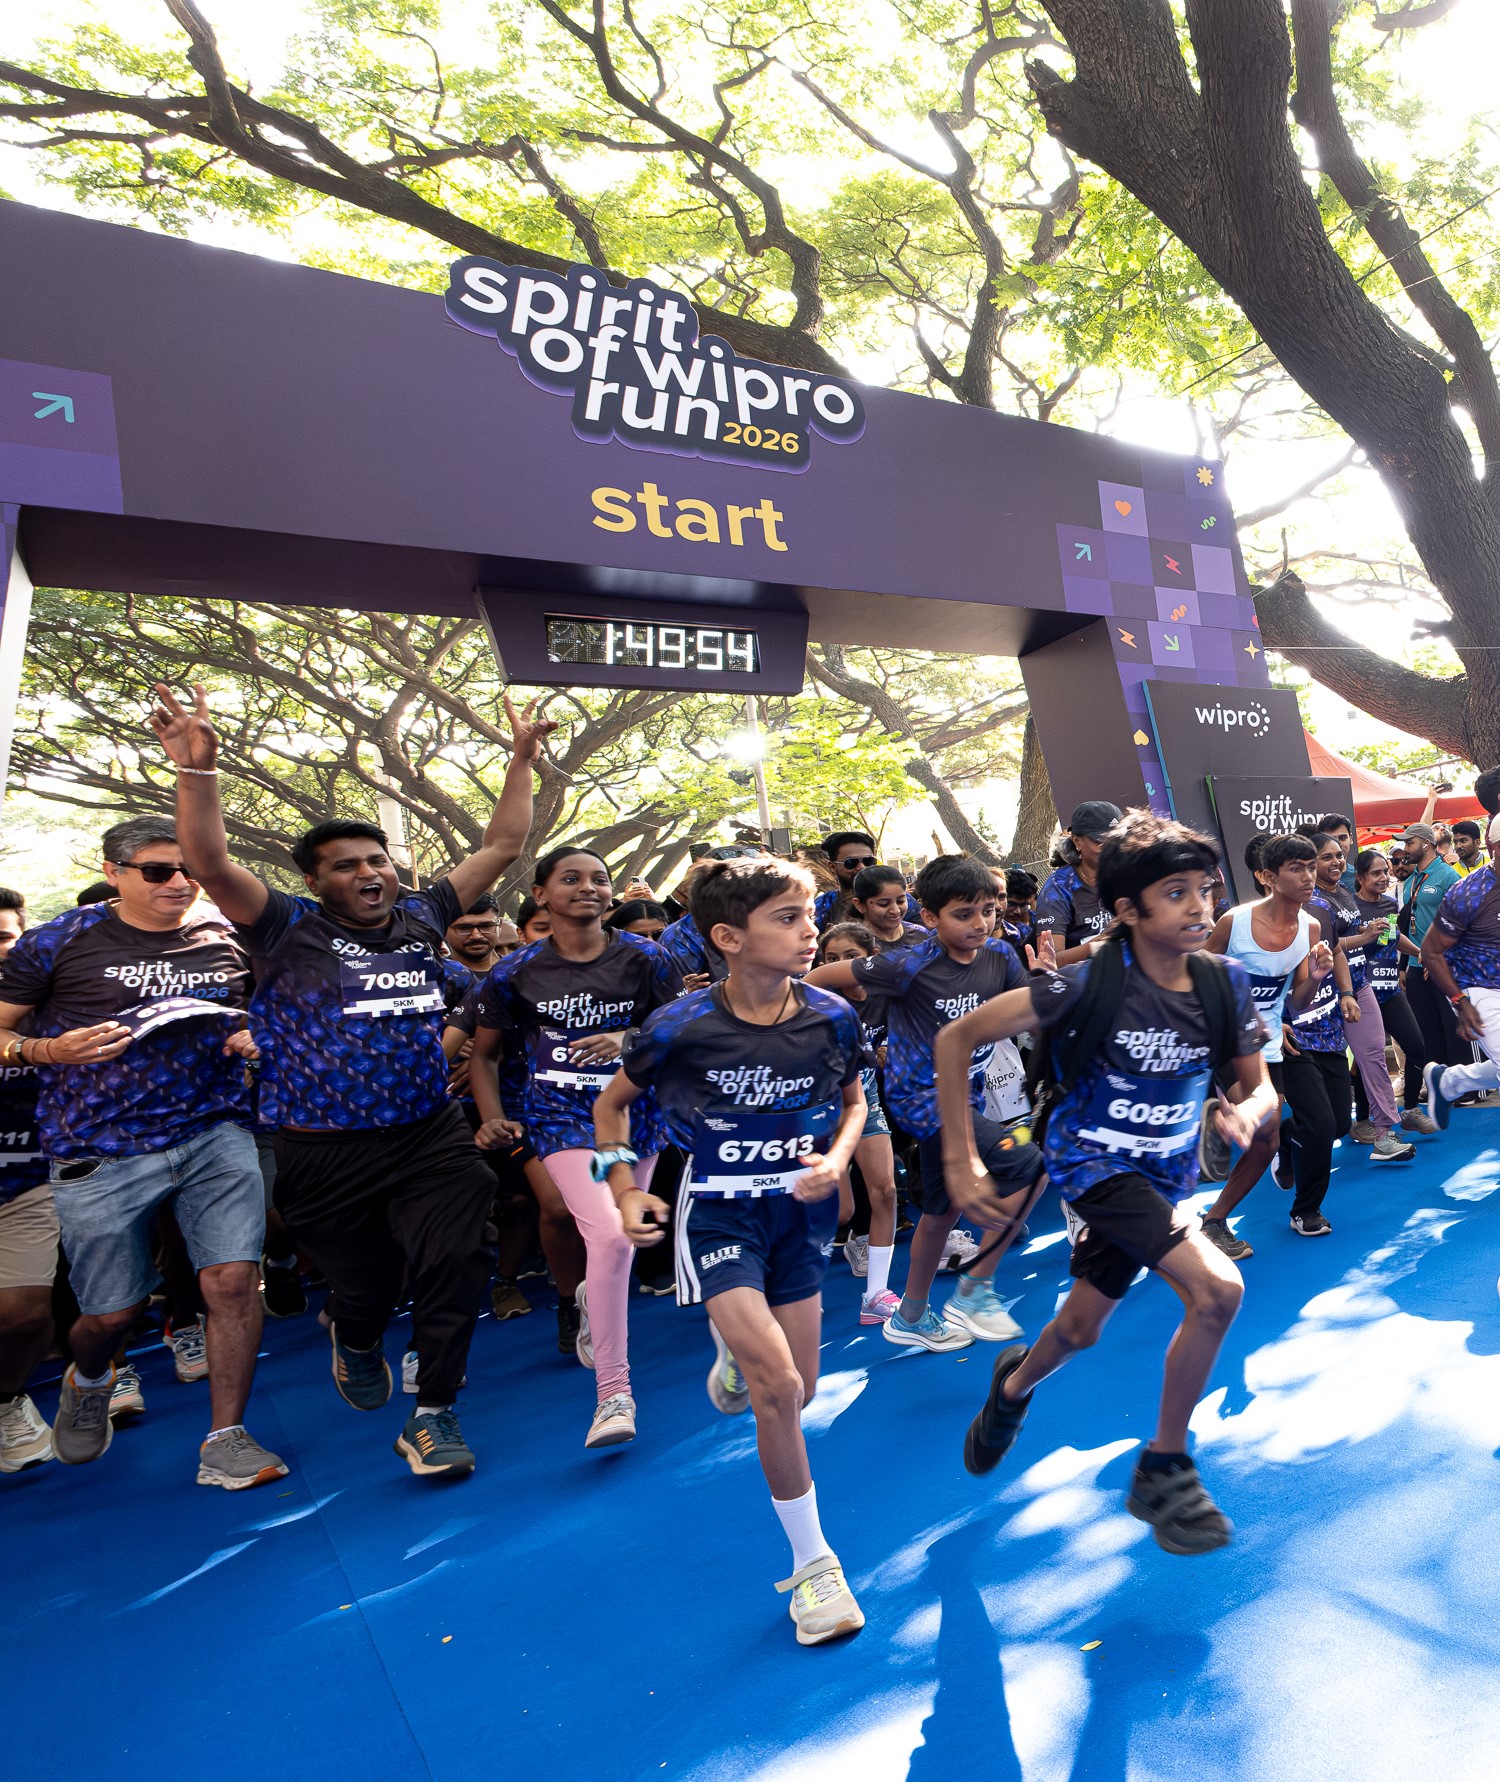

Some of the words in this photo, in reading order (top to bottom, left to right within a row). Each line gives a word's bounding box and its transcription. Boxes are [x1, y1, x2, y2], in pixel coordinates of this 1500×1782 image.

[459, 266, 686, 352] spirit
[529, 325, 628, 380] of
[633, 345, 856, 425] wipro
[584, 376, 720, 441] run
[722, 421, 800, 454] 2026
[590, 481, 789, 552] start
[606, 623, 753, 673] 1:49:54
[1194, 702, 1261, 733] wipro
[1239, 794, 1292, 820] spirit
[1255, 809, 1279, 830] of
[1280, 808, 1332, 829] wipr
[104, 961, 173, 981] spirit
[124, 972, 157, 988] of
[158, 969, 228, 990] wipro
[359, 970, 426, 991] 70801
[139, 983, 184, 998] run
[184, 986, 230, 998] 2026
[1250, 986, 1278, 997] 077
[1309, 985, 1333, 1005] 343
[393, 999, 415, 1008] 5KM
[536, 992, 593, 1015] spirit
[552, 1006, 579, 1021] of
[579, 1000, 634, 1018] wipro
[935, 993, 980, 1012] spirit
[947, 1004, 967, 1019] of
[566, 1014, 602, 1028] run
[601, 1016, 632, 1028] 202
[1114, 1027, 1181, 1050] spirit
[1128, 1042, 1162, 1059] of
[1139, 1056, 1182, 1072] run
[576, 1075, 597, 1083] 5KM
[705, 1065, 773, 1086] spirit
[987, 1072, 1015, 1085] wipro
[721, 1078, 752, 1095] of
[751, 1076, 815, 1097] wipro
[733, 1092, 776, 1106] run
[771, 1092, 811, 1111] 2026
[1107, 1098, 1197, 1125] 60822
[718, 1134, 815, 1163] 67613
[752, 1177, 780, 1187] 5KM
[700, 1245, 742, 1266] ELITE
